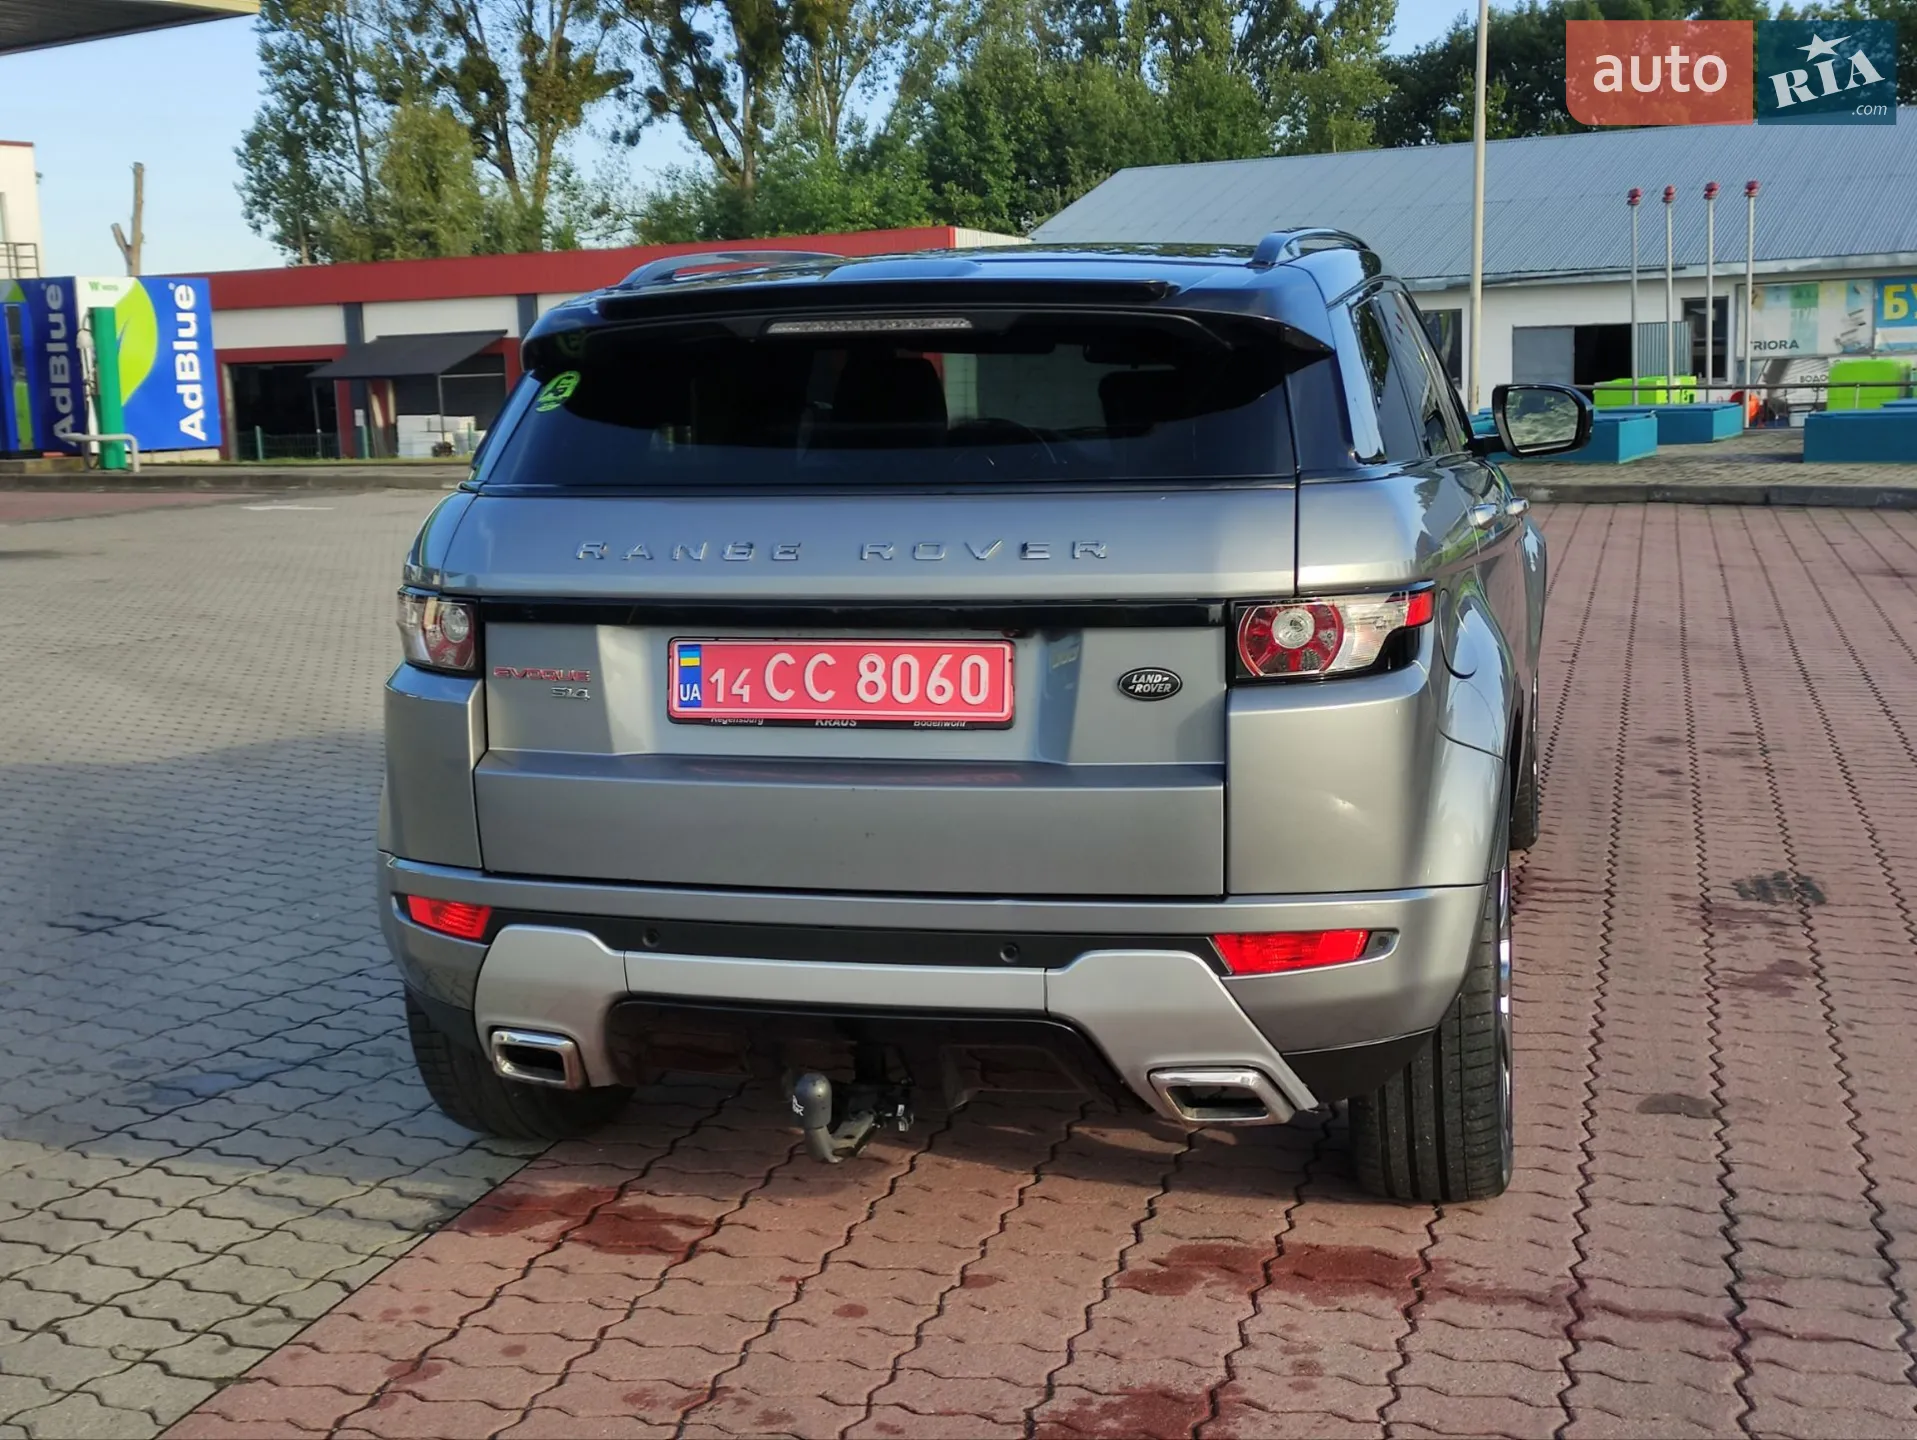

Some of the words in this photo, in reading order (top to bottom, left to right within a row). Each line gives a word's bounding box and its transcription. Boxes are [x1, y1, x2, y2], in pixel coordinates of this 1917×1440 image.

[1883, 283, 1917, 321] Б
[575, 541, 802, 561] RANGE
[858, 539, 1108, 561] ROVER
[493, 666, 591, 682] EVOQUE
[708, 668, 752, 703] 14
[764, 652, 836, 702] CC
[856, 653, 990, 705] 8060
[679, 683, 701, 701] UA
[815, 718, 858, 727] KRAUS
